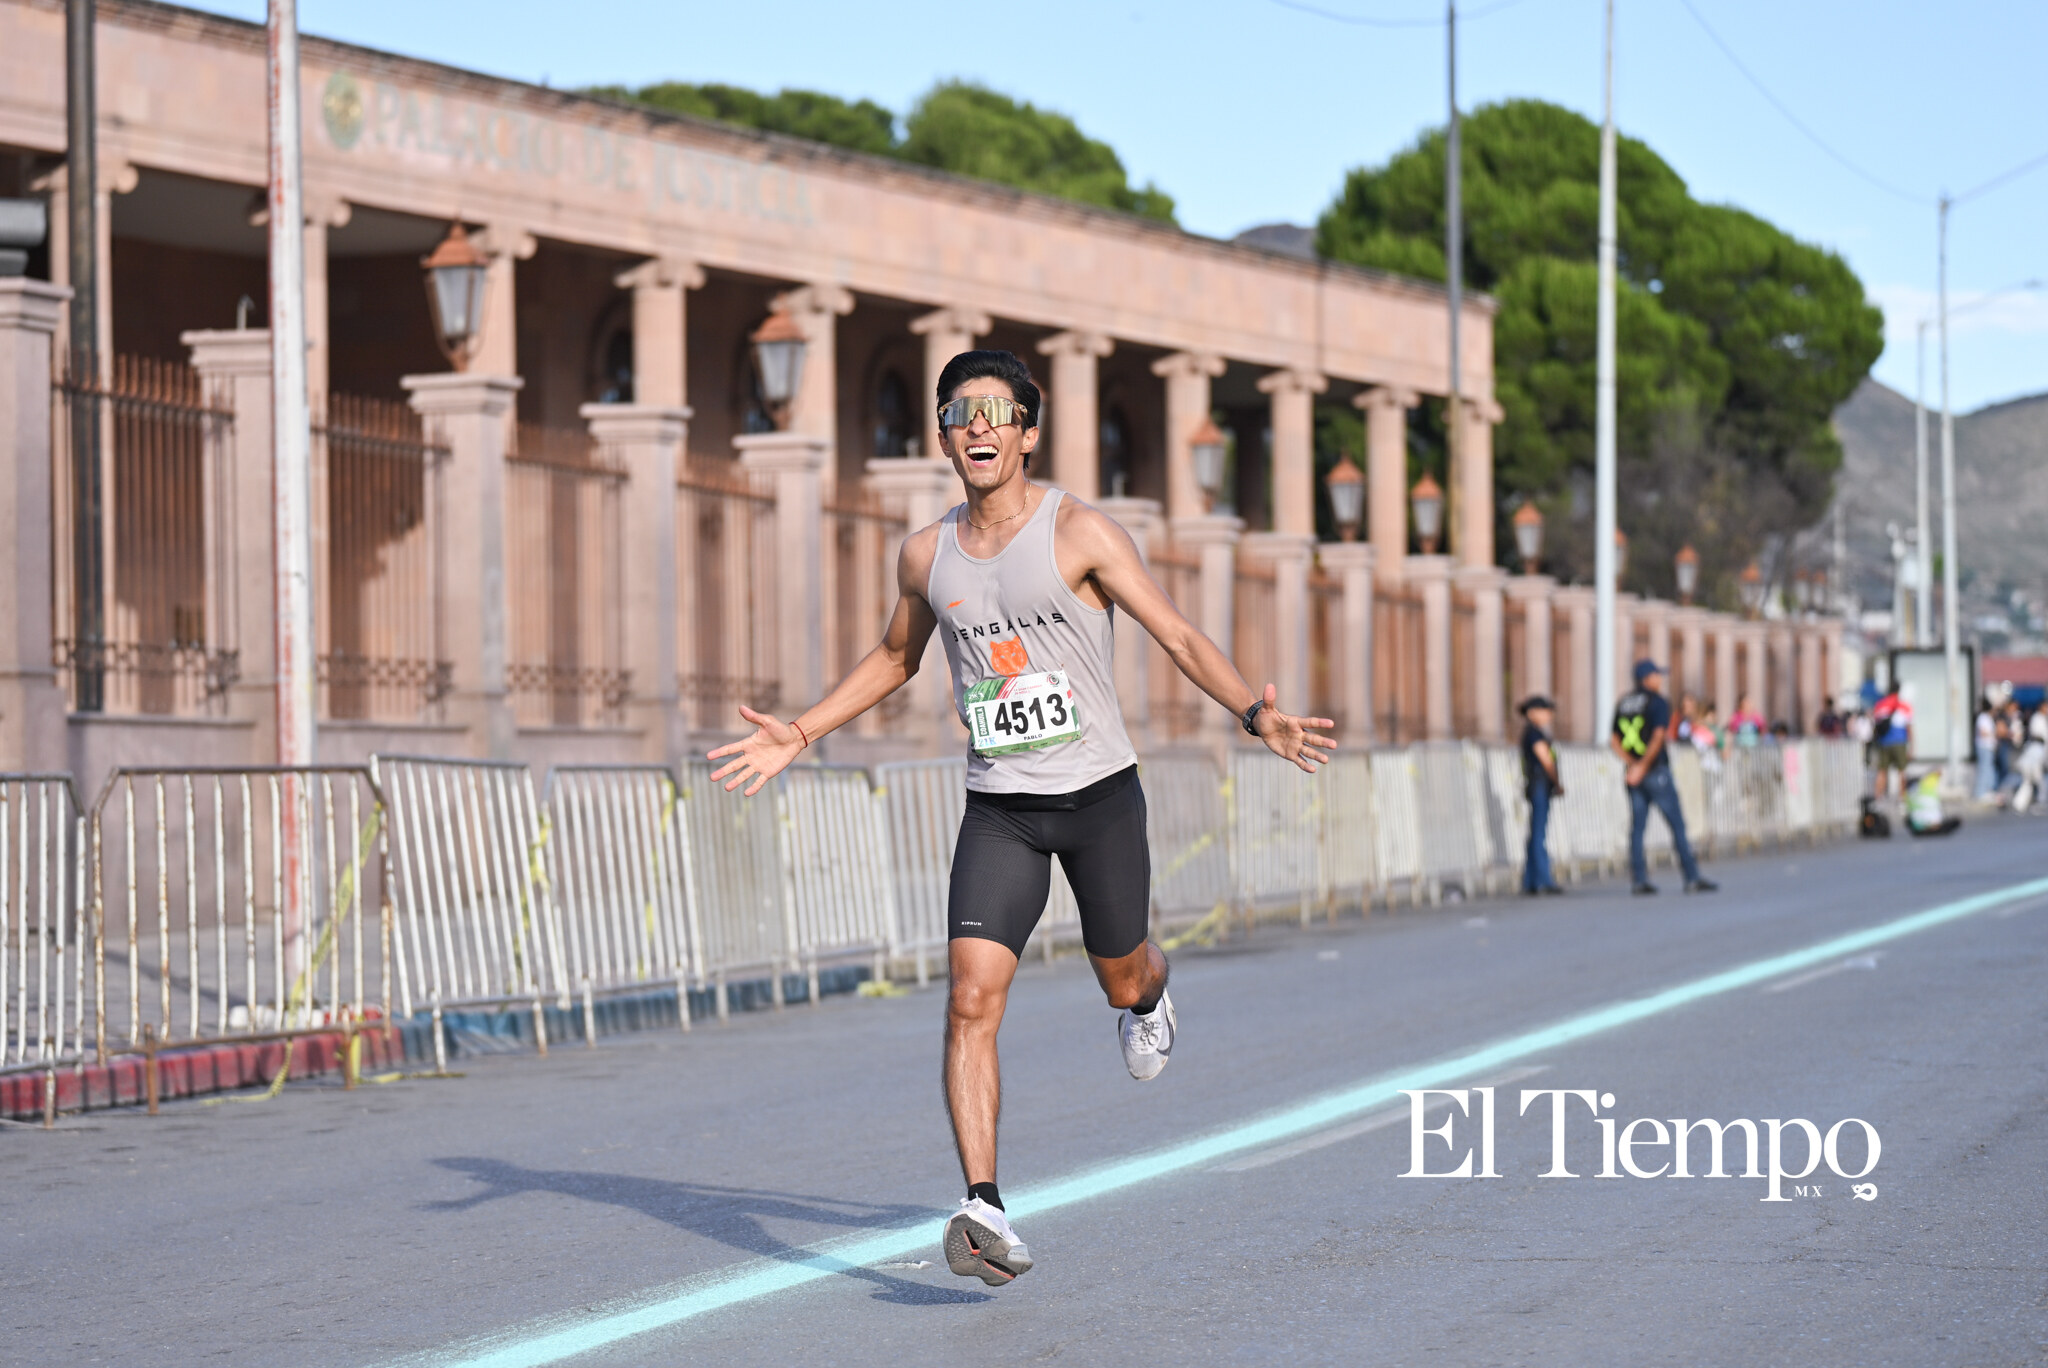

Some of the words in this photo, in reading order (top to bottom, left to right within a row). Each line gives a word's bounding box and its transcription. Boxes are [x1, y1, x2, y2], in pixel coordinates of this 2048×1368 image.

[374, 80, 565, 180] PALACIO
[582, 122, 641, 193] DE
[645, 136, 818, 226] JUSTICIA
[994, 693, 1067, 736] 4513
[977, 736, 997, 748] 21K
[1023, 733, 1043, 741] PABLO
